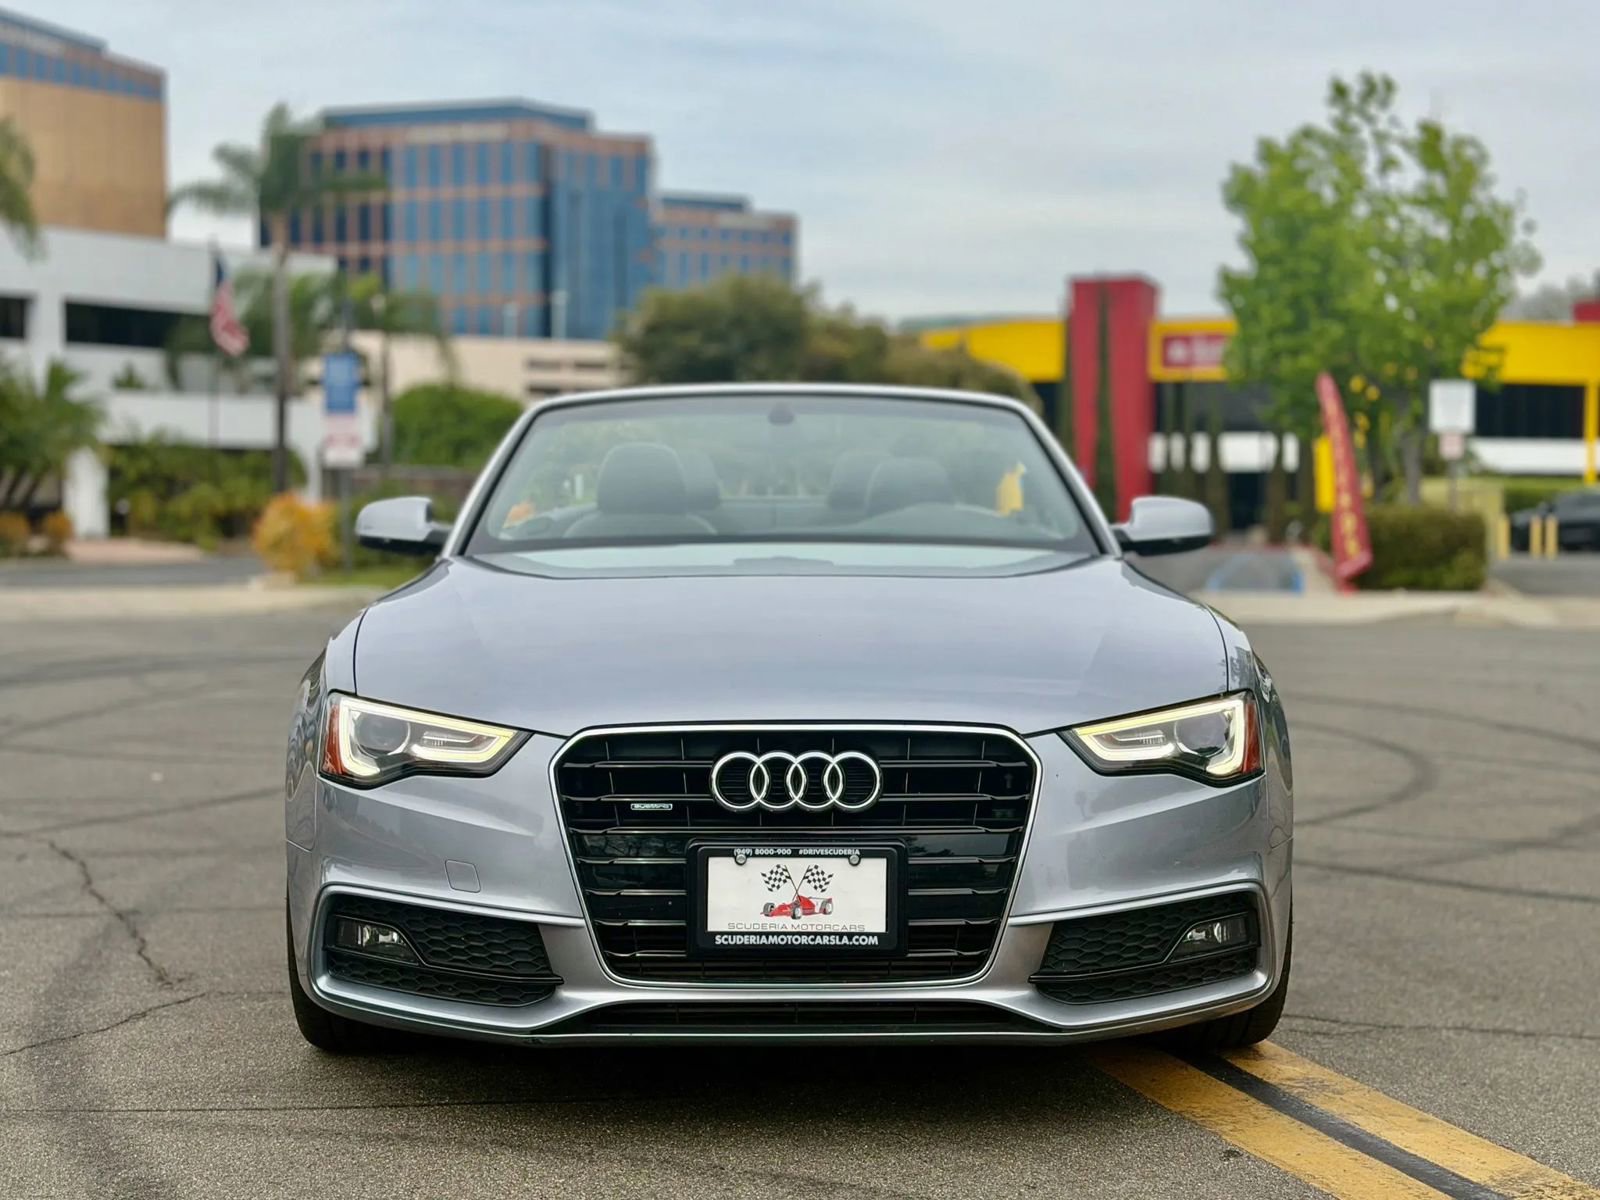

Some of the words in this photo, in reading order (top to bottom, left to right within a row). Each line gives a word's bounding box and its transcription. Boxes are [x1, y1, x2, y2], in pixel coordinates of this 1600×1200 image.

[727, 922, 788, 931] SCUDERIA
[791, 923, 866, 932] MOTORCARS
[714, 934, 879, 946] SCUDERIAMOTORCARSLA.COM
